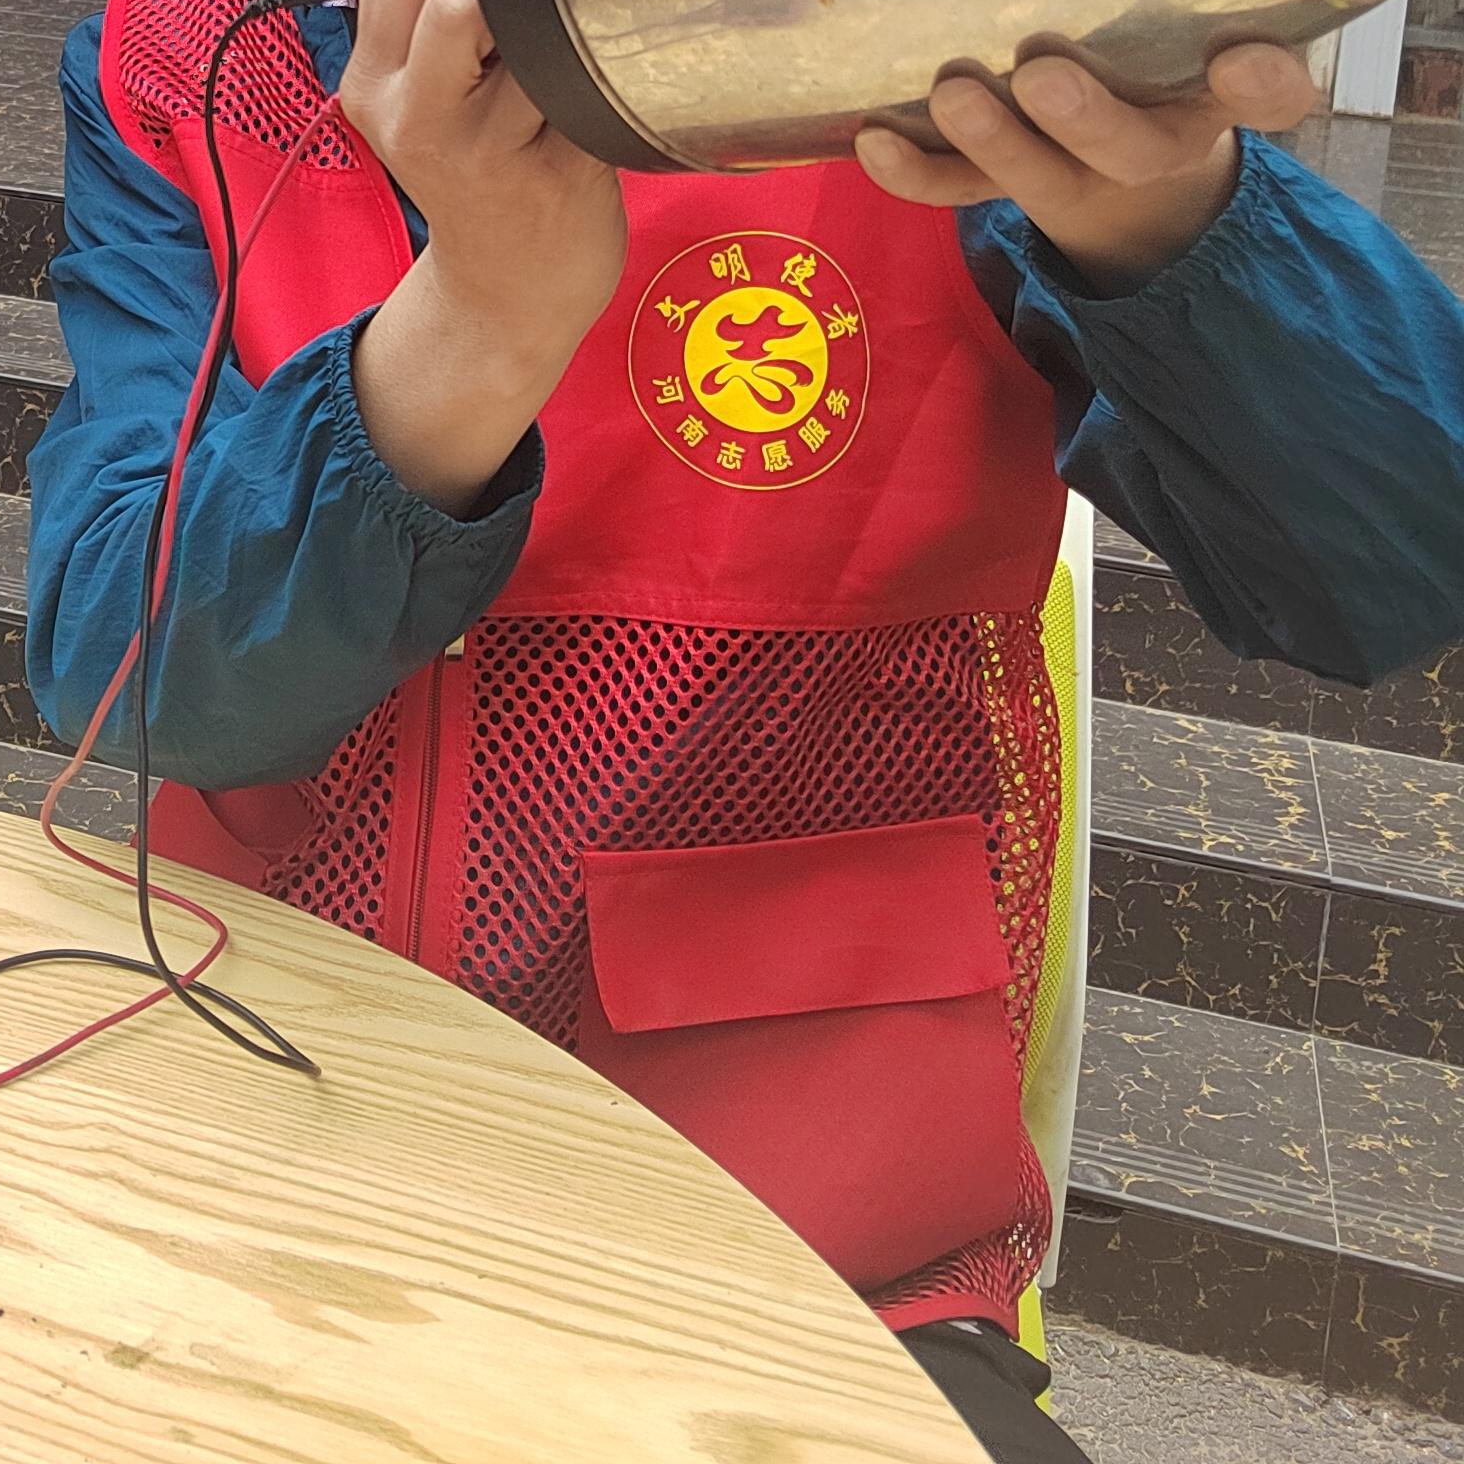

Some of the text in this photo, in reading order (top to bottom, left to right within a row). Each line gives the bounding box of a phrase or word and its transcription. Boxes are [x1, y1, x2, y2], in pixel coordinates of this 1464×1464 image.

[653, 243, 859, 340] 文明使者
[652, 374, 851, 473] 河南志愿服务
